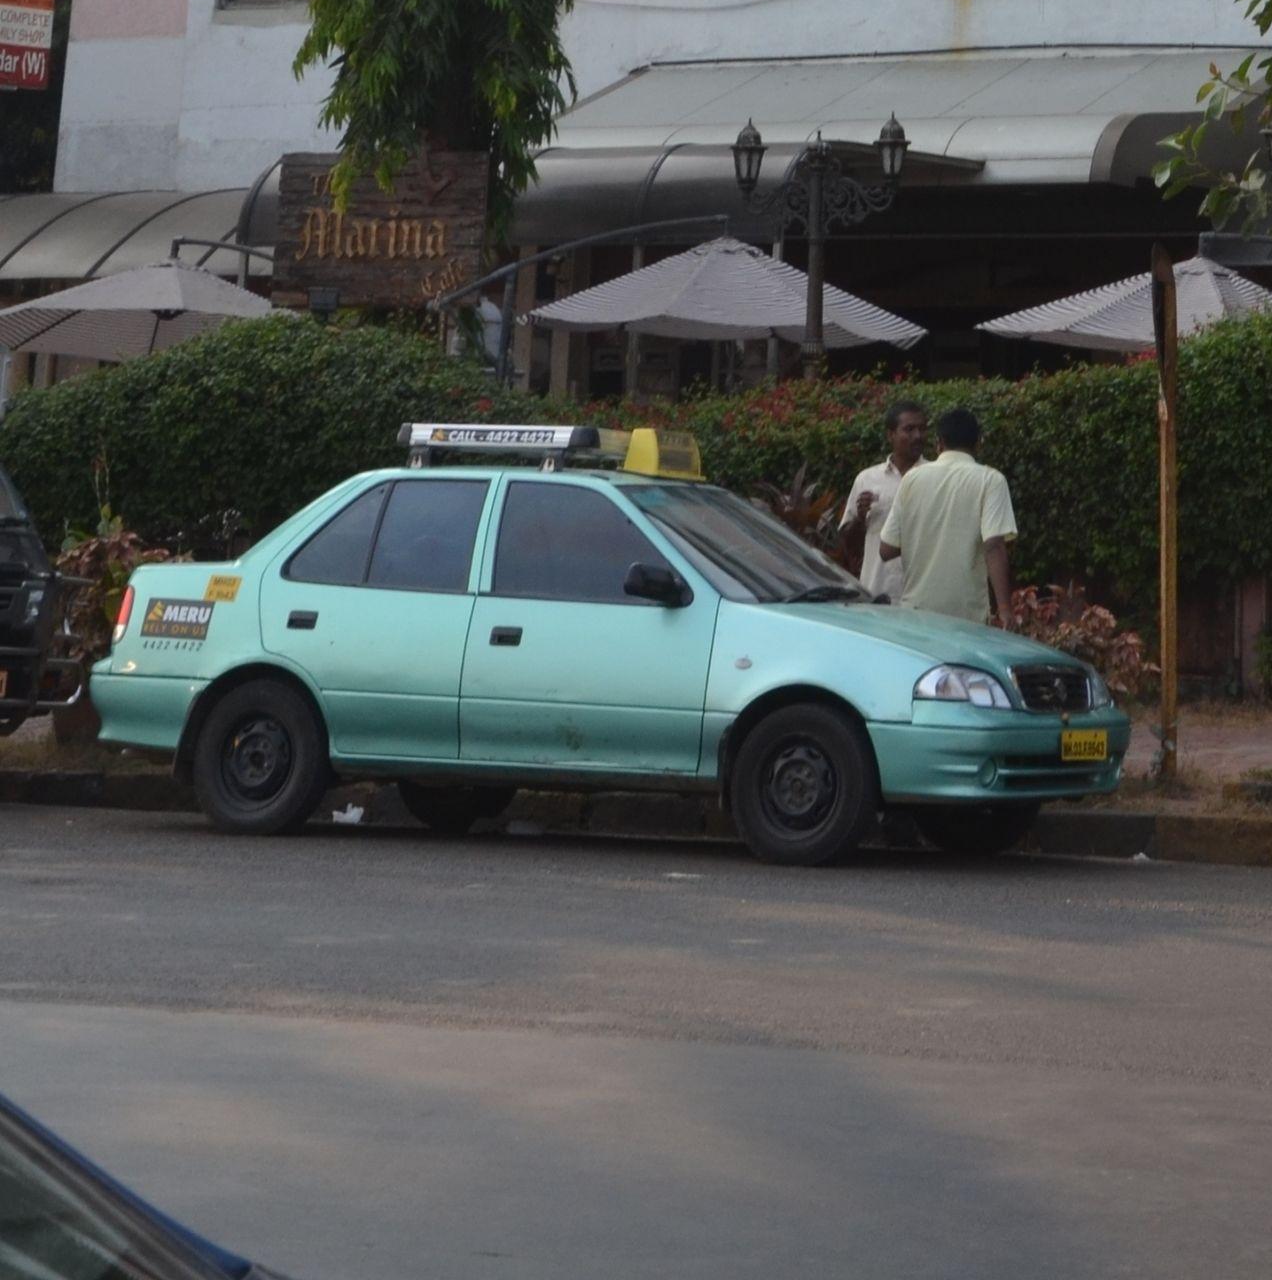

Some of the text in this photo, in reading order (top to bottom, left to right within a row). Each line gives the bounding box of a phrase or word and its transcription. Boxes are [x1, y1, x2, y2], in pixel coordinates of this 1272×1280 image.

[1, 8, 49, 27] COMPLETE
[22, 50, 45, 81] (W)
[295, 207, 449, 260] Marina
[448, 429, 476, 441] CALL
[485, 430, 519, 442] 4422
[520, 431, 554, 444] 4422
[163, 605, 212, 623] MERU
[143, 623, 205, 636] RELY ON US
[143, 640, 203, 652] 4422 4422
